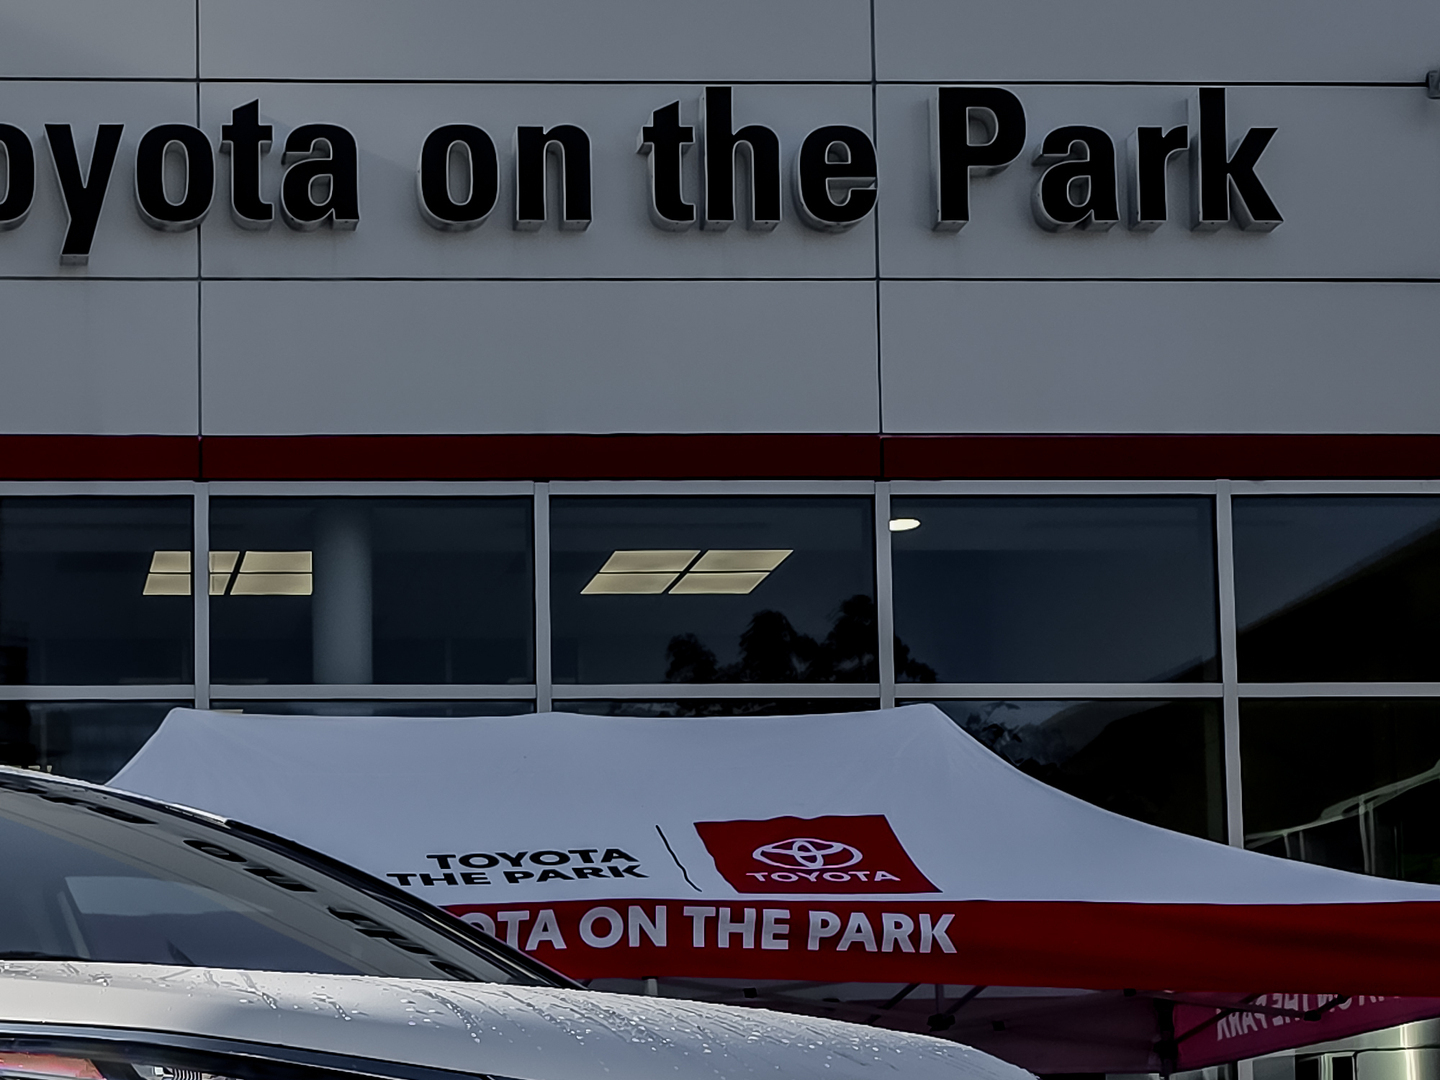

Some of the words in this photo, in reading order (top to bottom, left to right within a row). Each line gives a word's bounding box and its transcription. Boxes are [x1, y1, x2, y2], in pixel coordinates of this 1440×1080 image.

[420, 122, 592, 230] on
[636, 85, 878, 232] the
[931, 86, 1283, 232] Park
[426, 848, 641, 870] TOYOTA
[386, 871, 491, 887] THE
[502, 864, 650, 884] PARK
[745, 870, 901, 883] TOYOTA
[579, 905, 667, 948] ON
[683, 906, 791, 949] THE
[807, 911, 958, 954] PARK
